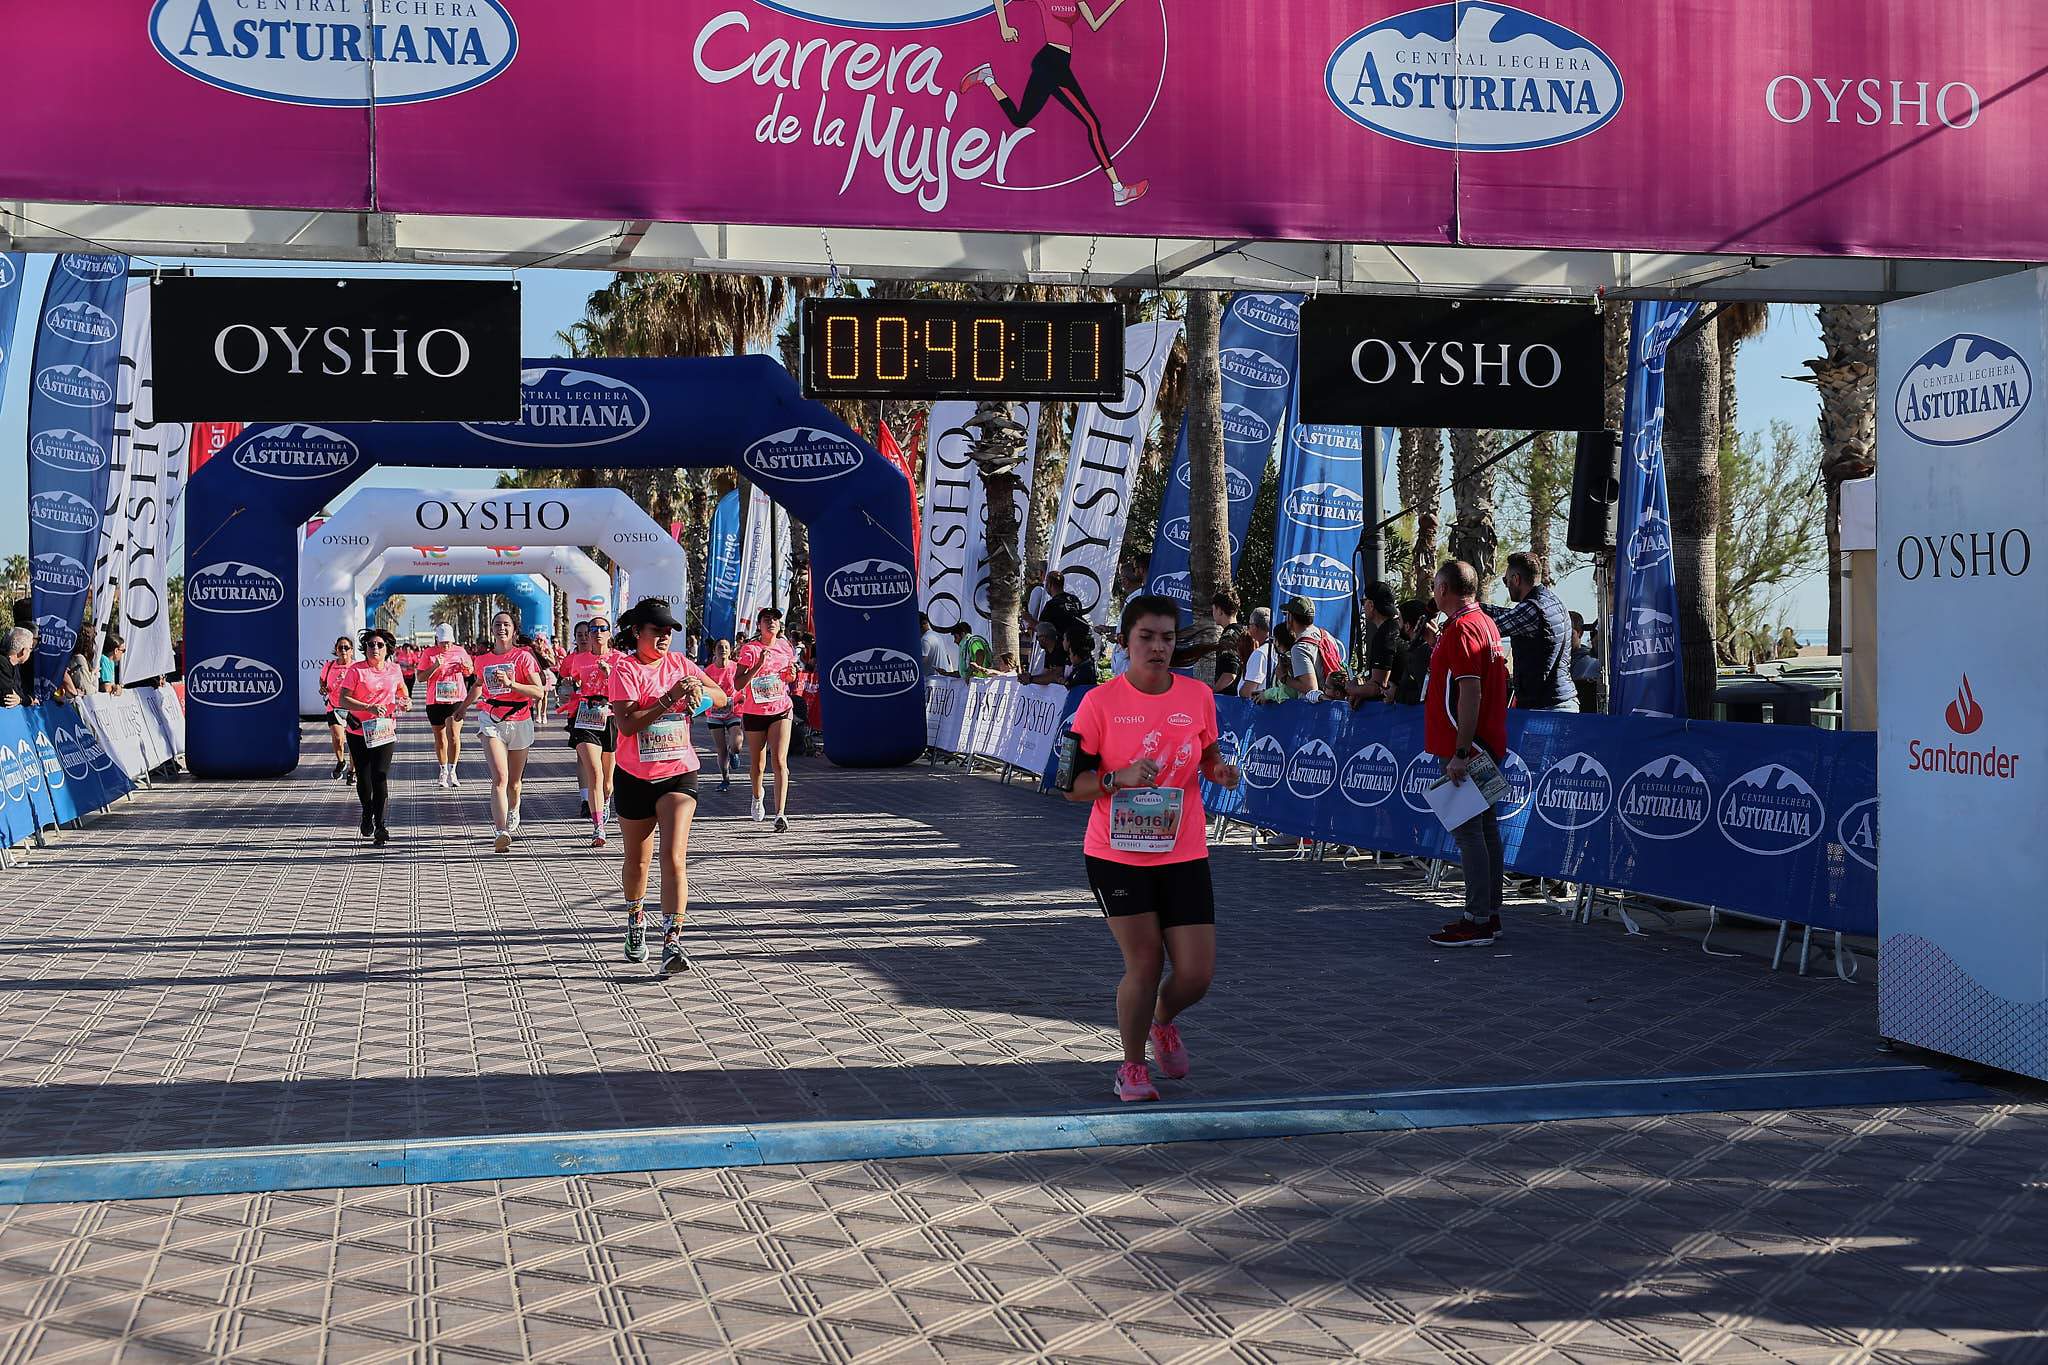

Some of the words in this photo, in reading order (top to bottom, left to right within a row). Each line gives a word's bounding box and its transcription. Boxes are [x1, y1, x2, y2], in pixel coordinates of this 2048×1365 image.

[236, 0, 350, 13] CENTRAL
[179, 0, 491, 65] ASTURIANA
[692, 12, 944, 95] Carrera
[1396, 50, 1487, 66] CENTRAL
[1498, 54, 1591, 71] LECHERA
[1349, 51, 1602, 114] ASTURIANA
[1765, 75, 1980, 129] OYSHO
[755, 100, 802, 144] de
[813, 92, 846, 148] la
[839, 91, 1036, 213] Mujer
[50, 311, 111, 338] ASTURIANA
[214, 323, 470, 378] OYSHO
[826, 315, 1099, 382] 00:40:11
[1219, 354, 1282, 385] ASTURIANA
[1351, 338, 1562, 389] OYSHO
[41, 374, 106, 401] ASTURIANA
[1923, 372, 1965, 389] CENTRAL
[1969, 364, 2016, 381] LECHERA
[521, 391, 560, 400] NTRAL
[567, 391, 628, 400] LECHERA
[1904, 380, 2021, 423] ASTURIANA
[469, 405, 635, 427] TURIANA
[1222, 419, 1264, 440] URIANA
[1298, 424, 1361, 450] ASTURIA
[35, 438, 100, 465] ASTURIANA
[240, 444, 349, 466] ASTURIANA
[261, 441, 300, 449] CENTRAL
[305, 442, 347, 450] LECHERA
[769, 445, 809, 453] CENTRAL
[812, 443, 850, 451] LECHERA
[754, 448, 857, 469] ASTURIANA
[31, 502, 93, 527] ASTURIANA
[415, 500, 570, 531] OYSHO
[1289, 496, 1364, 521] ASTURIANA
[322, 535, 369, 546] OYSHO
[613, 532, 658, 543] OYSHO
[926, 427, 974, 634] OYSHO
[1897, 528, 2031, 580] OYSHO
[715, 534, 740, 600] Marlene
[1279, 567, 1350, 592] ASTURIANA
[191, 580, 278, 600] ASTURIANA
[831, 579, 910, 598] ASTURIANA
[1155, 582, 1192, 601] ASTUR
[302, 597, 346, 608] OYSHO
[301, 660, 328, 671] OYS
[836, 667, 916, 686] ASTURIANA
[191, 673, 276, 694] ASTURIANA
[1013, 695, 1056, 735] OYSHO
[1114, 715, 1145, 724] OYSHO
[1909, 739, 2019, 779] Santander
[1289, 759, 1331, 785] ASTURIANA
[1343, 764, 1393, 792] ASTURIANA
[1539, 778, 1604, 812] ASTURIANA
[1641, 782, 1671, 793] CENTRAL
[1673, 785, 1703, 795] LECHERA
[1742, 793, 1775, 805] CENTRAL
[1777, 796, 1811, 809] LECHERA
[1624, 783, 1702, 821] ASTURIANA
[1723, 793, 1811, 836] ASTURIANA
